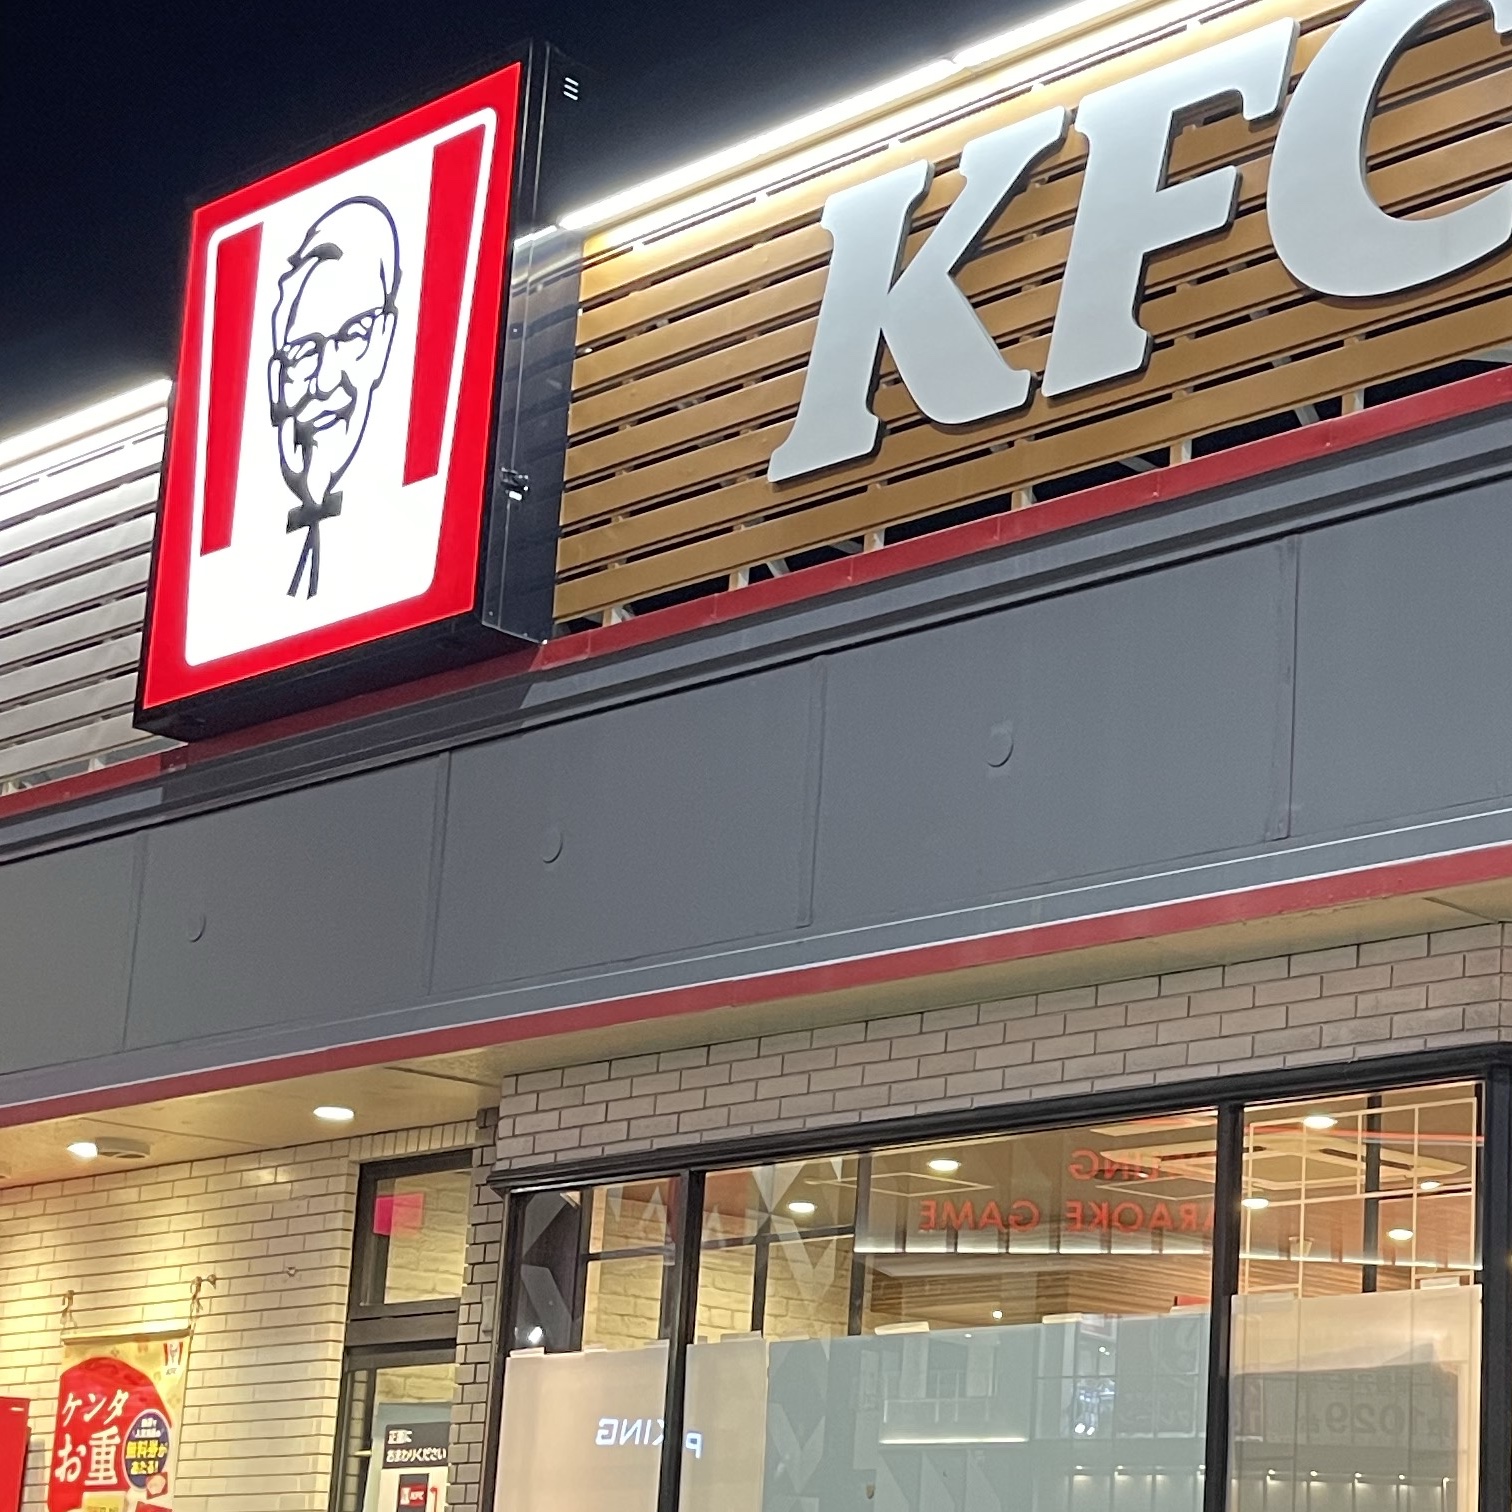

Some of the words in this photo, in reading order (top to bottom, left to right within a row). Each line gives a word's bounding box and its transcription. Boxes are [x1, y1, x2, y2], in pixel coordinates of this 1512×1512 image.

[61, 1388, 129, 1427] ケンタ
[54, 1425, 121, 1486] お重
[386, 1447, 446, 1463] おまわりください
